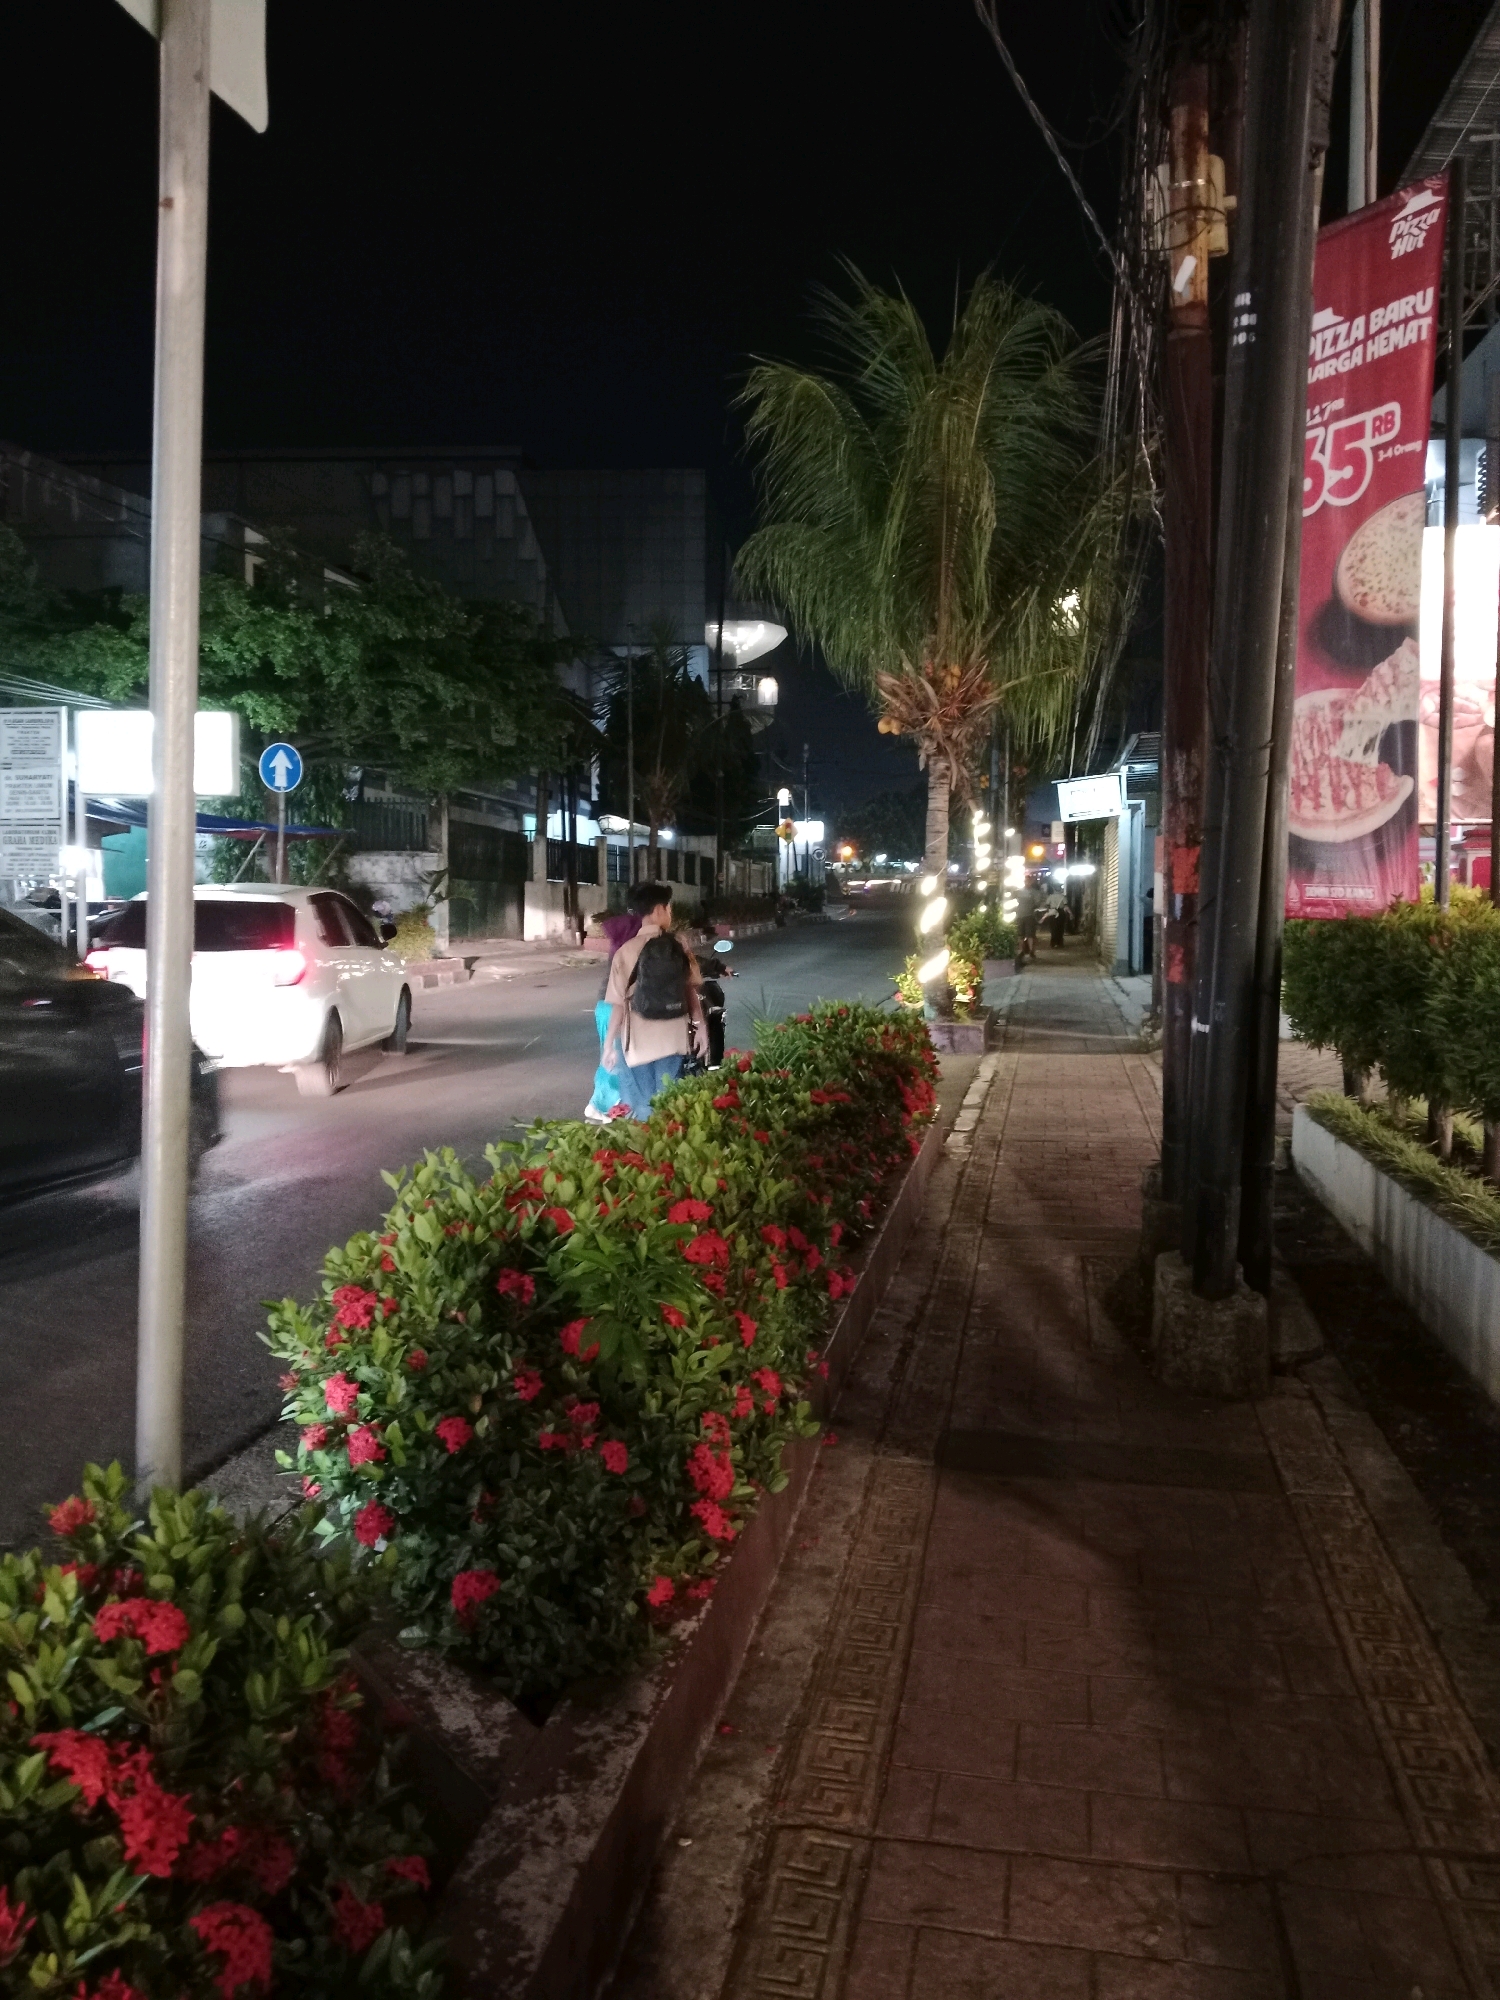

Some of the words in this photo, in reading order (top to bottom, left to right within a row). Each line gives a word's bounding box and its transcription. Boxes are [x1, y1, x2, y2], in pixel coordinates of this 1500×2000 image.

[1369, 286, 1435, 330] BARU
[1366, 317, 1433, 363] HEMAT
[3, 835, 27, 846] GRAHA
